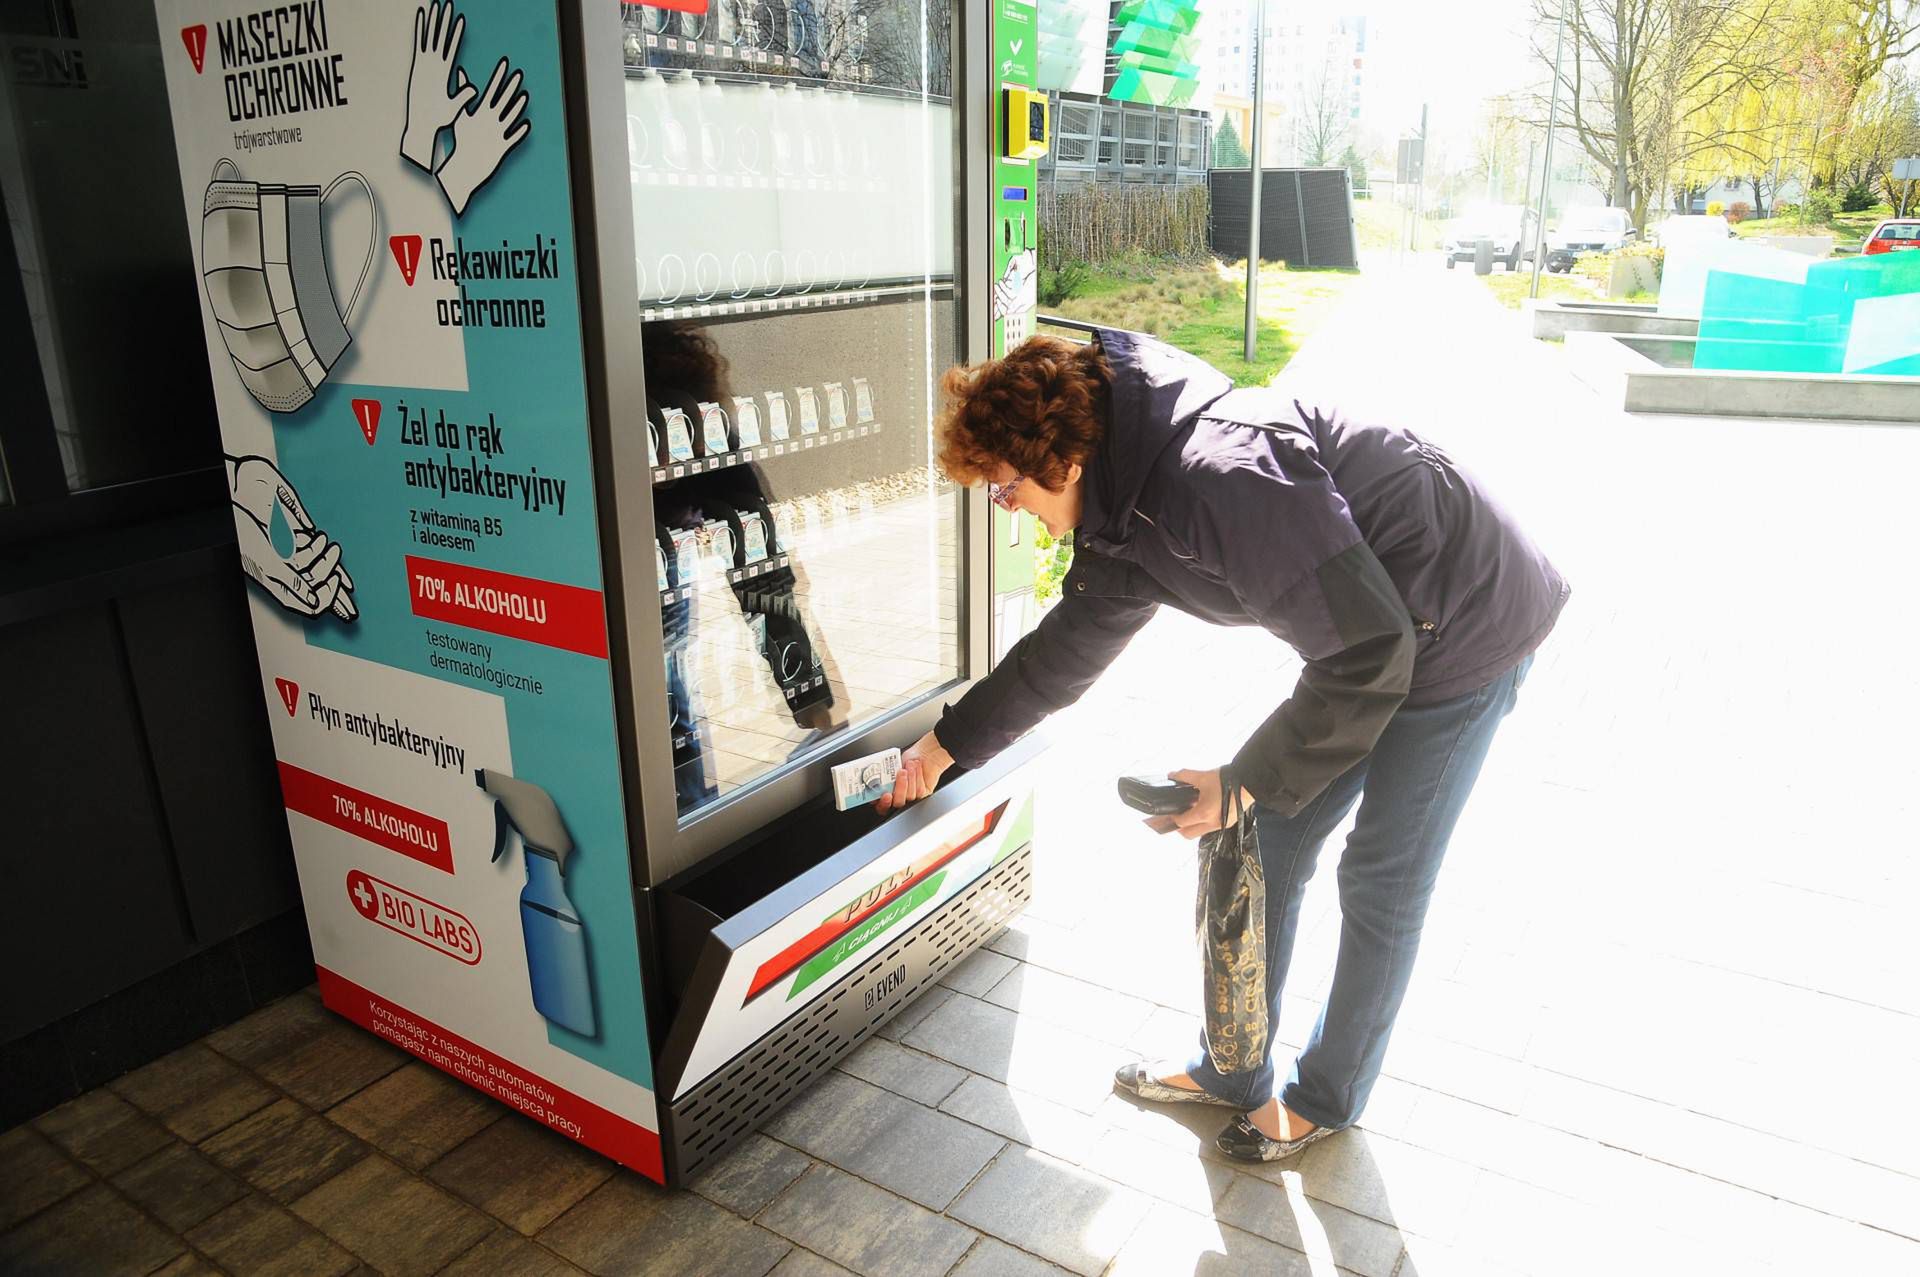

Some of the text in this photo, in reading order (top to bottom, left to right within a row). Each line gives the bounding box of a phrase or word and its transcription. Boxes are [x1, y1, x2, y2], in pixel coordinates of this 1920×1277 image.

[216, 0, 329, 69] MASECZKI
[224, 54, 348, 122] OCHRONNE
[234, 127, 302, 153] trójwarstwowe
[429, 234, 559, 286] Rękawiczki
[436, 284, 546, 328] ochronne
[397, 400, 504, 459] Żel do rąk
[404, 453, 566, 516] antybakteryjny
[410, 508, 503, 537] z witaminą B5
[411, 525, 475, 552] i aloesem
[415, 574, 547, 625] 70% ALKOHOLU
[426, 629, 492, 663] testowany
[430, 651, 543, 695] dermatologicznie
[308, 692, 465, 774] Płyn antybakteryjny
[332, 794, 438, 852] 70% ALKOHOLU
[381, 891, 473, 954] BIO LABS
[844, 866, 914, 924] PULL
[877, 964, 906, 1002] EVEND
[369, 1000, 555, 1106] Korzystając z naszych automatów
[373, 1020, 584, 1138] pomagasz nam chronić miejsca pracy.
